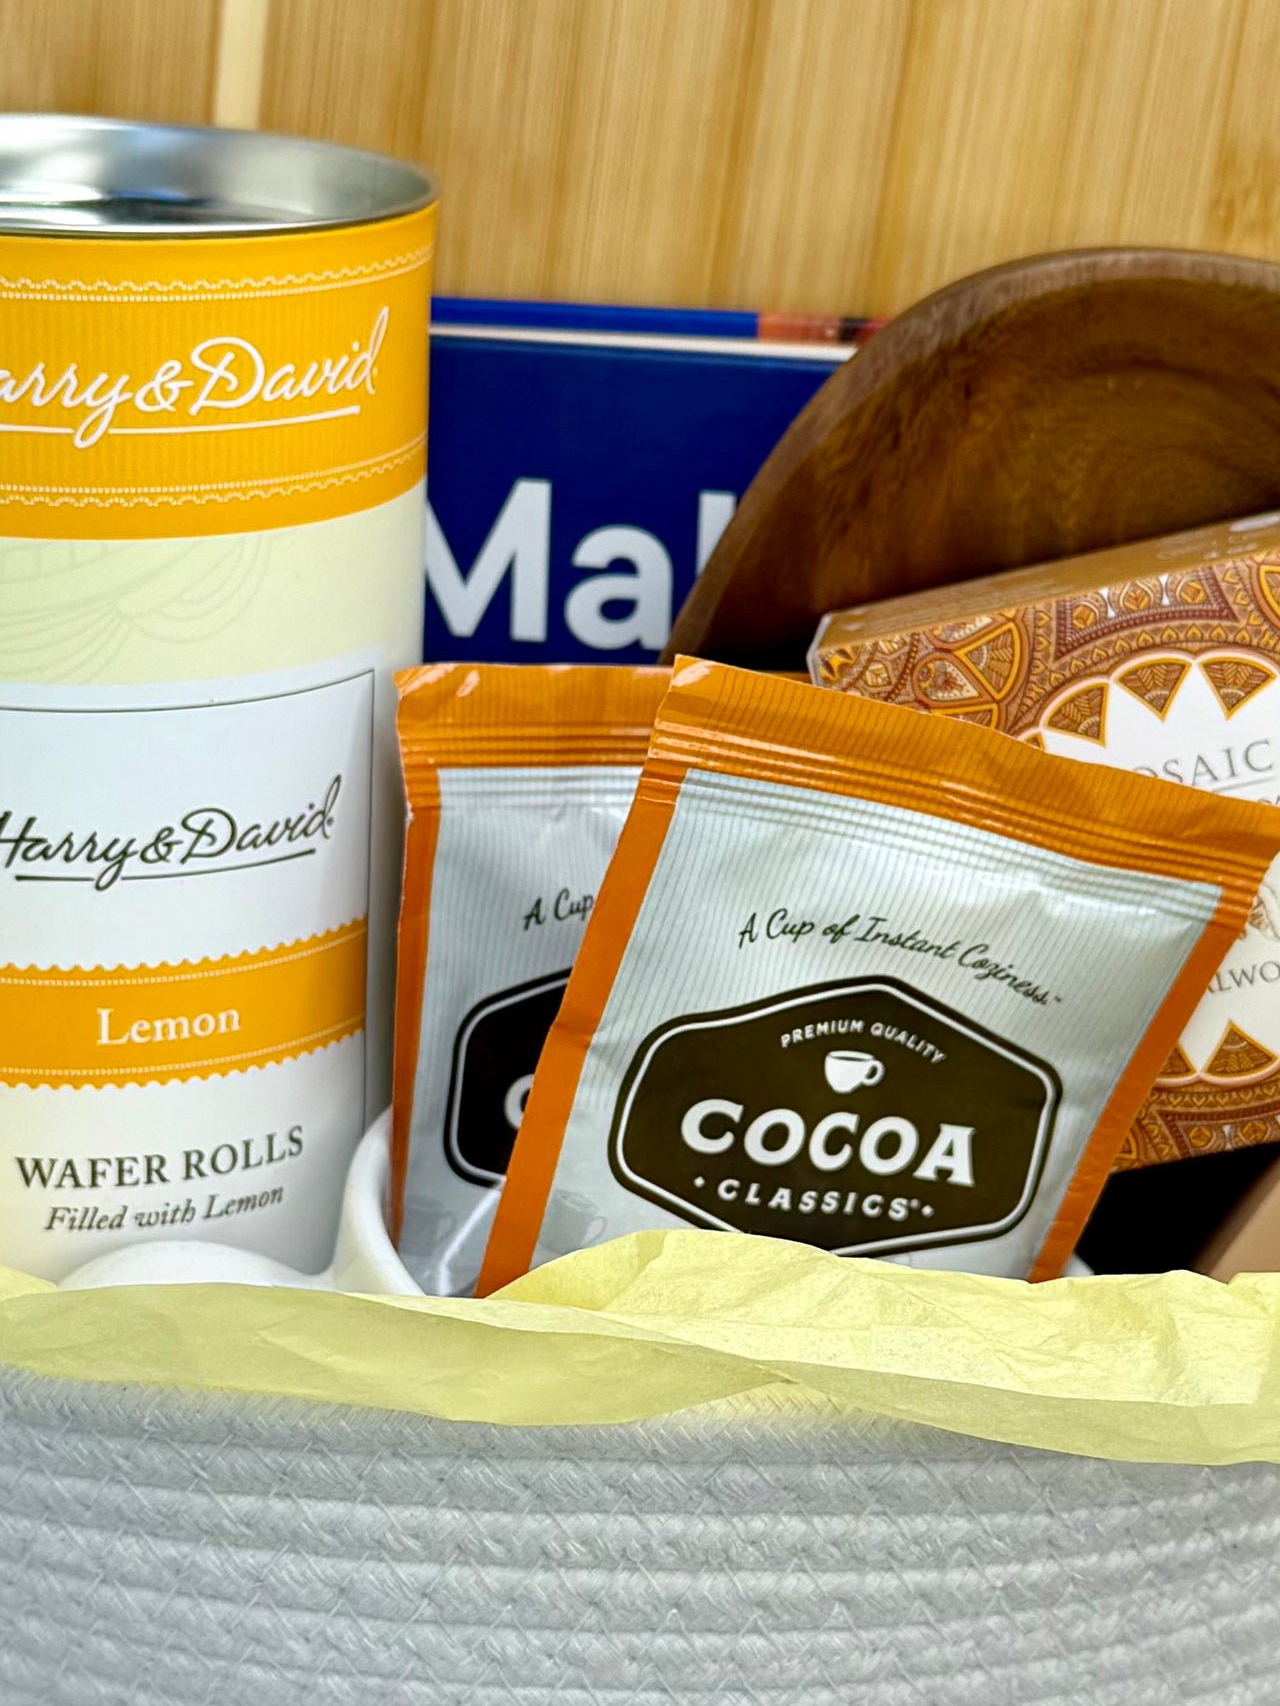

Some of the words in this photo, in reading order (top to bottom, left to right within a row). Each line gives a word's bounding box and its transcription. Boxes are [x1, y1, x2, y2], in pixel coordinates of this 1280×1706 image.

[524, 898, 546, 931] A
[554, 888, 594, 922] Cup
[739, 912, 757, 949] A
[766, 908, 814, 942] Cup
[822, 914, 860, 943] of
[855, 916, 959, 960] Instant
[96, 1007, 241, 1046] Lemon
[781, 1019, 865, 1049] PREMIUM
[870, 1021, 947, 1064] QUALITY
[15, 1154, 171, 1189] WAFER
[182, 1125, 304, 1180] ROLLS
[681, 1098, 976, 1188] COCOA
[44, 1205, 128, 1231] Filled
[134, 1198, 196, 1228] with
[202, 1186, 284, 1220] Lemon
[717, 1178, 910, 1221] CLASSICS
